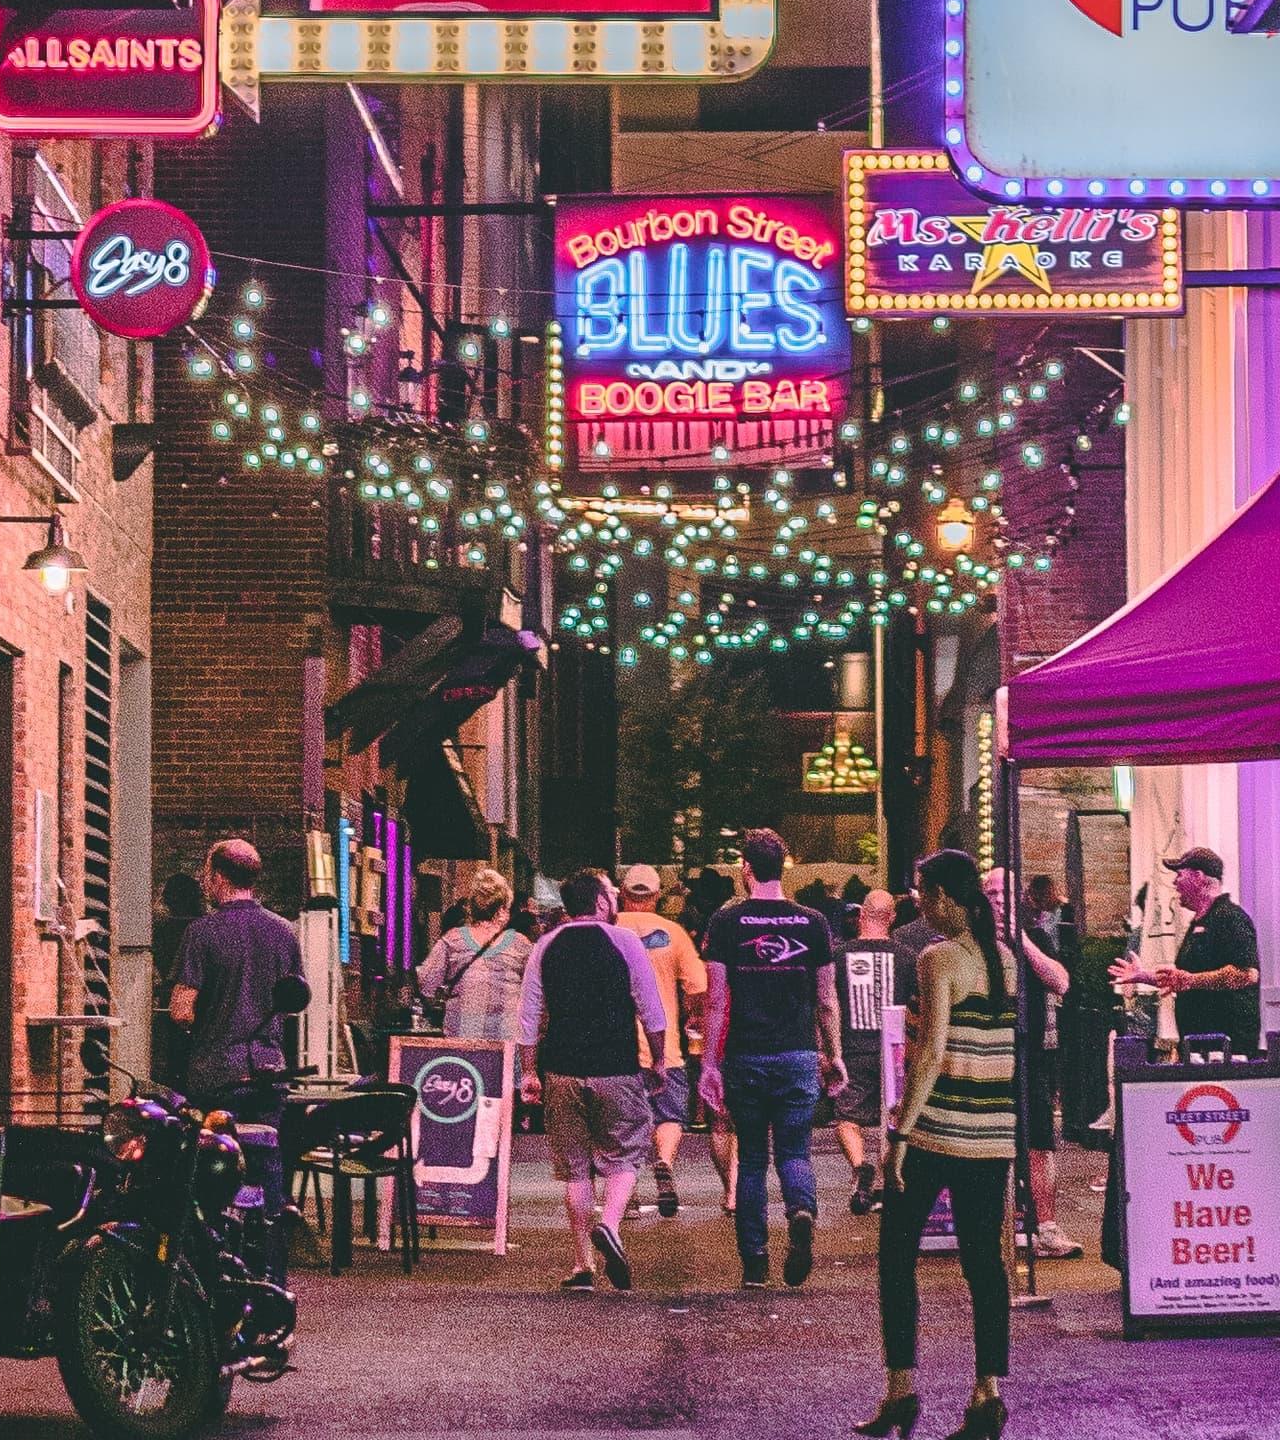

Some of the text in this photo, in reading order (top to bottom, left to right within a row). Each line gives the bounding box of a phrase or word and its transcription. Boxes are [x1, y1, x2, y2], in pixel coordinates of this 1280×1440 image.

[568, 206, 834, 269] Bourbon Street
[866, 206, 1159, 246] Ms. Kelli's
[897, 251, 1123, 271] KARAOKE
[576, 243, 823, 355] BLUES
[651, 360, 750, 380] AND
[579, 380, 831, 415] BOOGIE BAR
[1187, 1163, 1235, 1190] We
[1173, 1201, 1252, 1227] Have
[1172, 1236, 1256, 1265] Beer!
[1150, 1274, 1280, 1291] (And amazing food)
